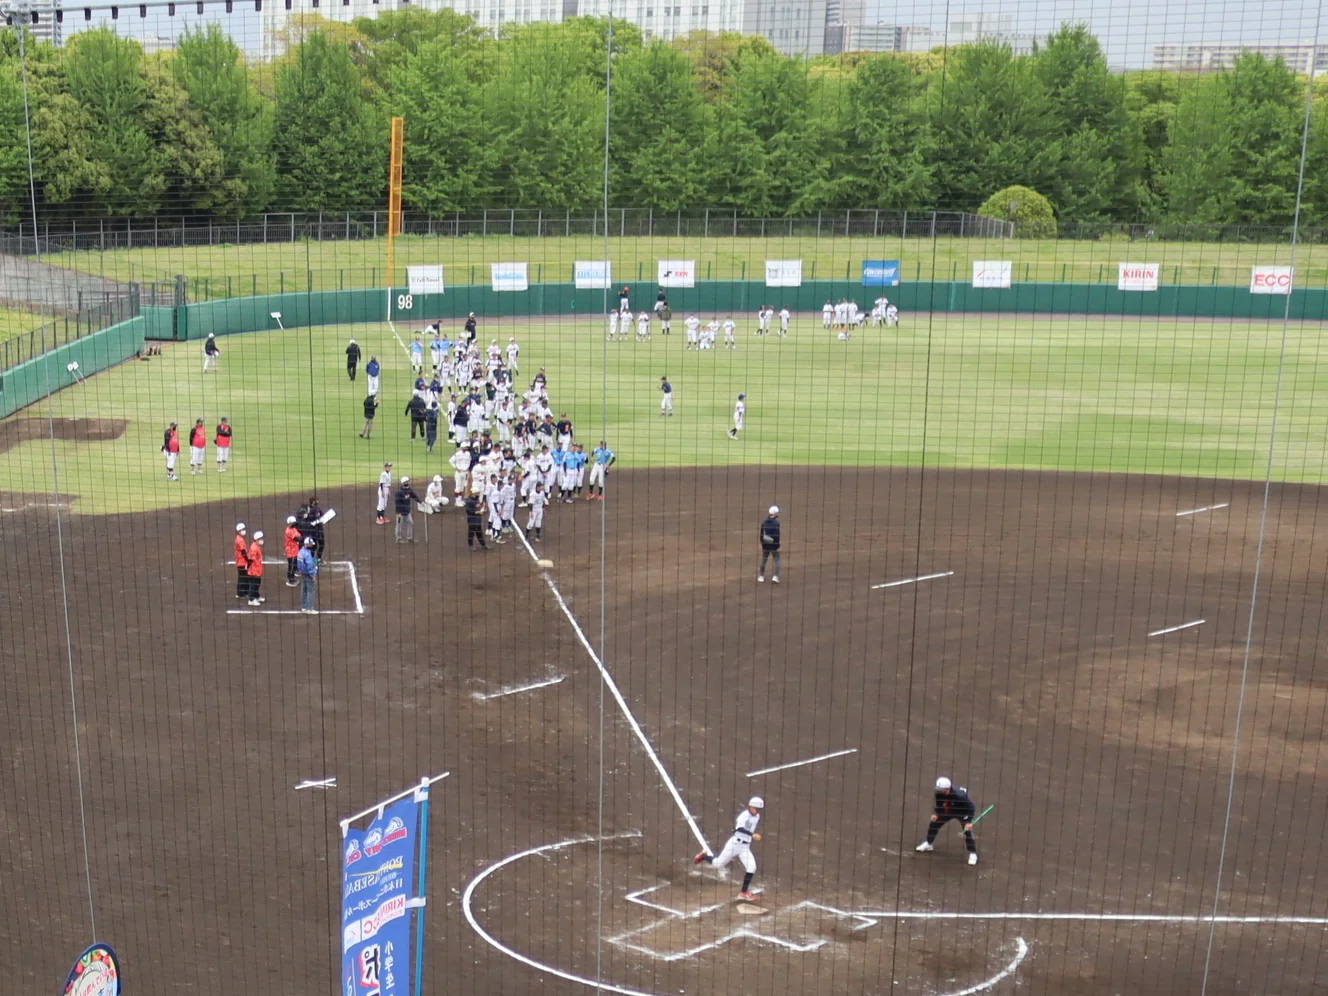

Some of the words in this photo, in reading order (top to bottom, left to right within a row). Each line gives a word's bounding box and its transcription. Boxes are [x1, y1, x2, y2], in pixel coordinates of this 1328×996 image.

[1123, 269, 1153, 279] KIRIN
[1254, 275, 1290, 287] ECC
[397, 294, 413, 310] 98
